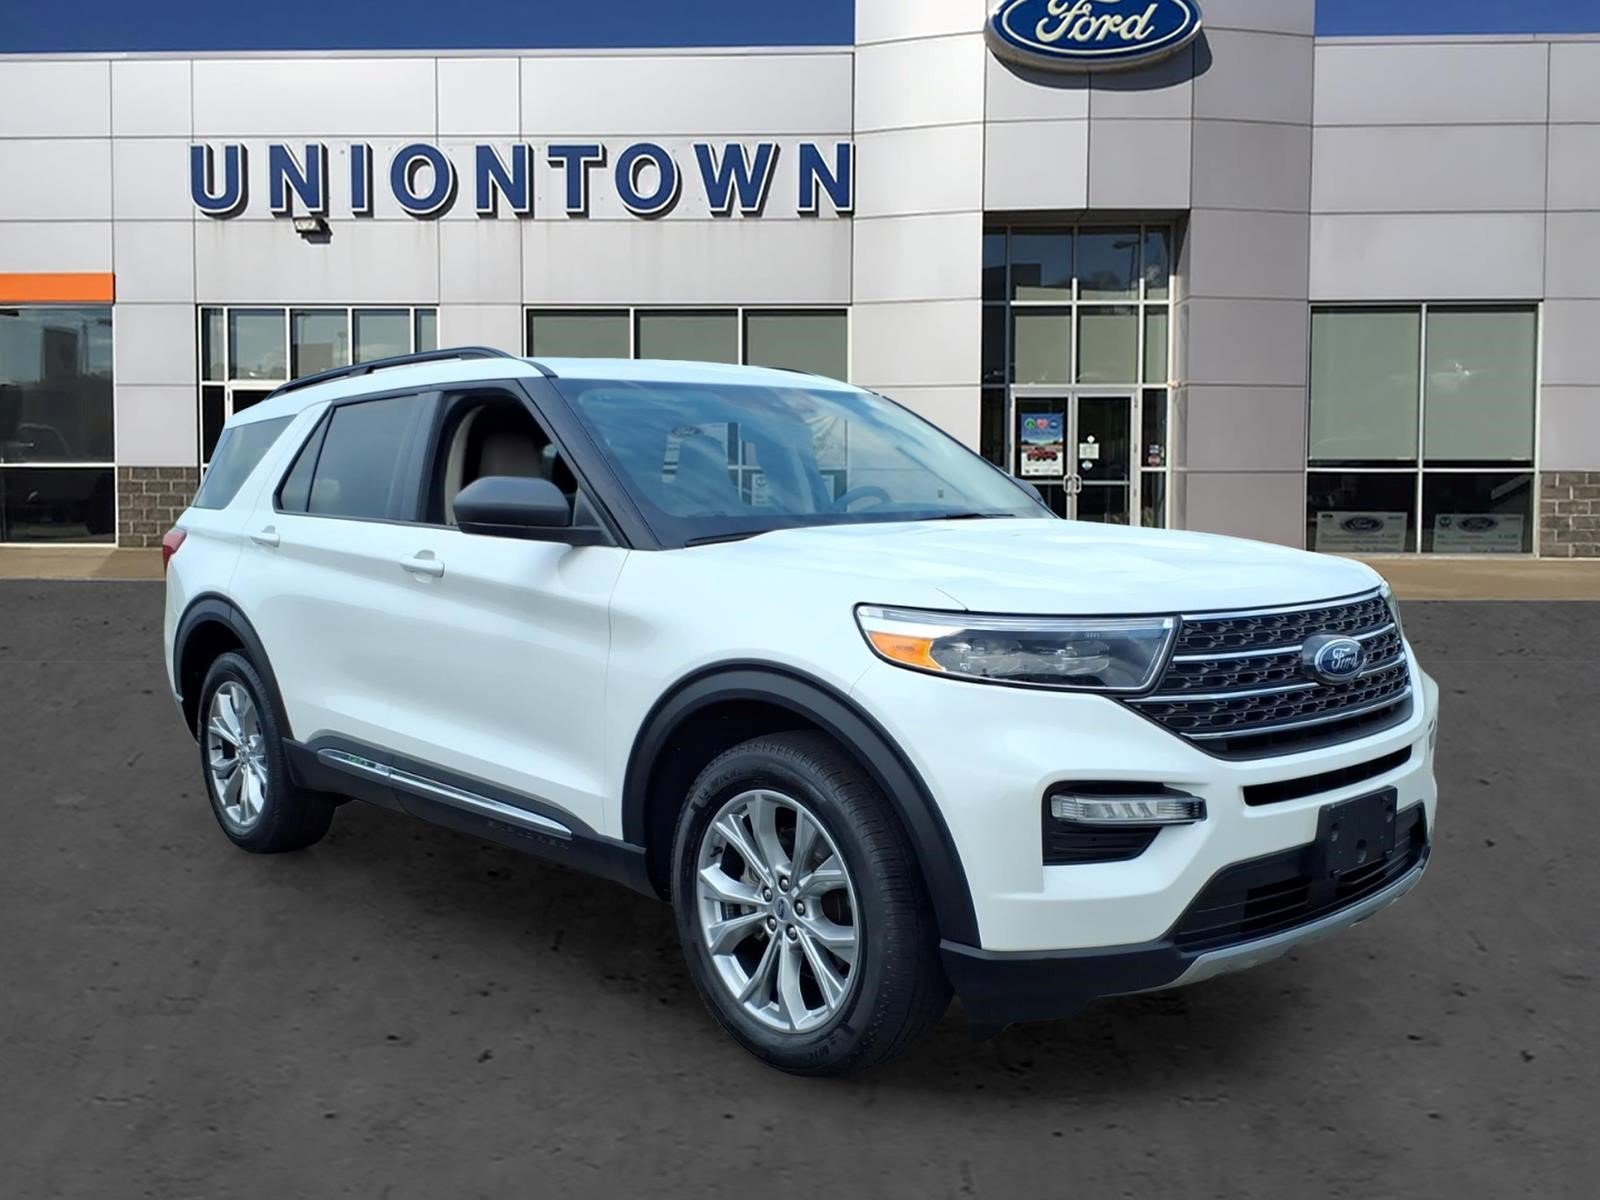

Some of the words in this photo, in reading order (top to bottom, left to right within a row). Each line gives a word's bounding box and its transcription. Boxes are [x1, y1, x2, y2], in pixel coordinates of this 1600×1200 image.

[1035, 0, 1157, 42] Ford
[190, 141, 854, 216] UNIONTOWN
[1331, 647, 1359, 670] Ford
